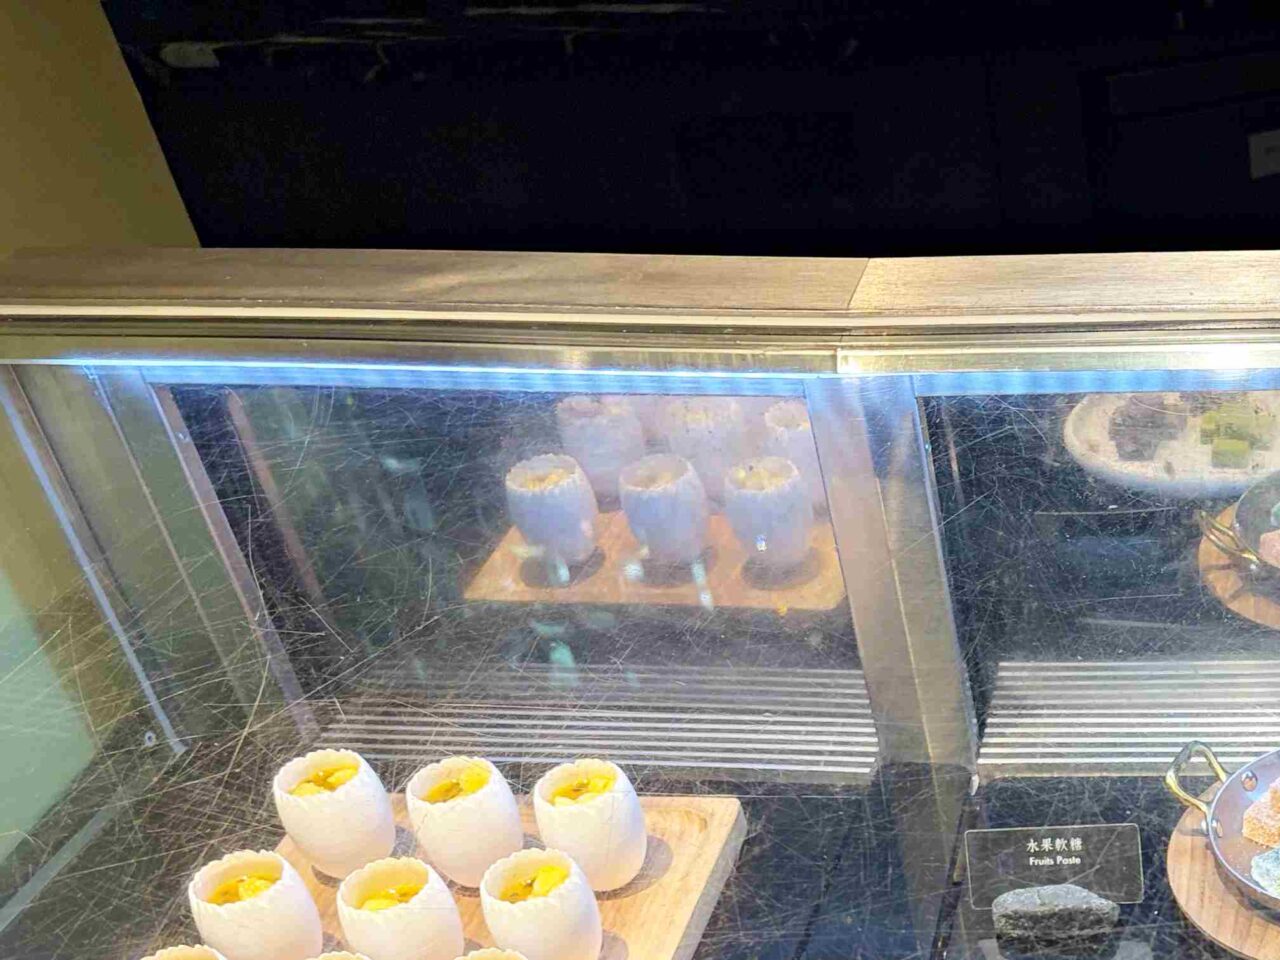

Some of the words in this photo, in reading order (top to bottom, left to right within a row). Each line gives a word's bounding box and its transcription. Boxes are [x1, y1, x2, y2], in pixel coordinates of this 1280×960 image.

[1026, 837, 1083, 853] 水果軟糖
[1029, 856, 1054, 866] Fruits
[1057, 855, 1081, 865] Paste
